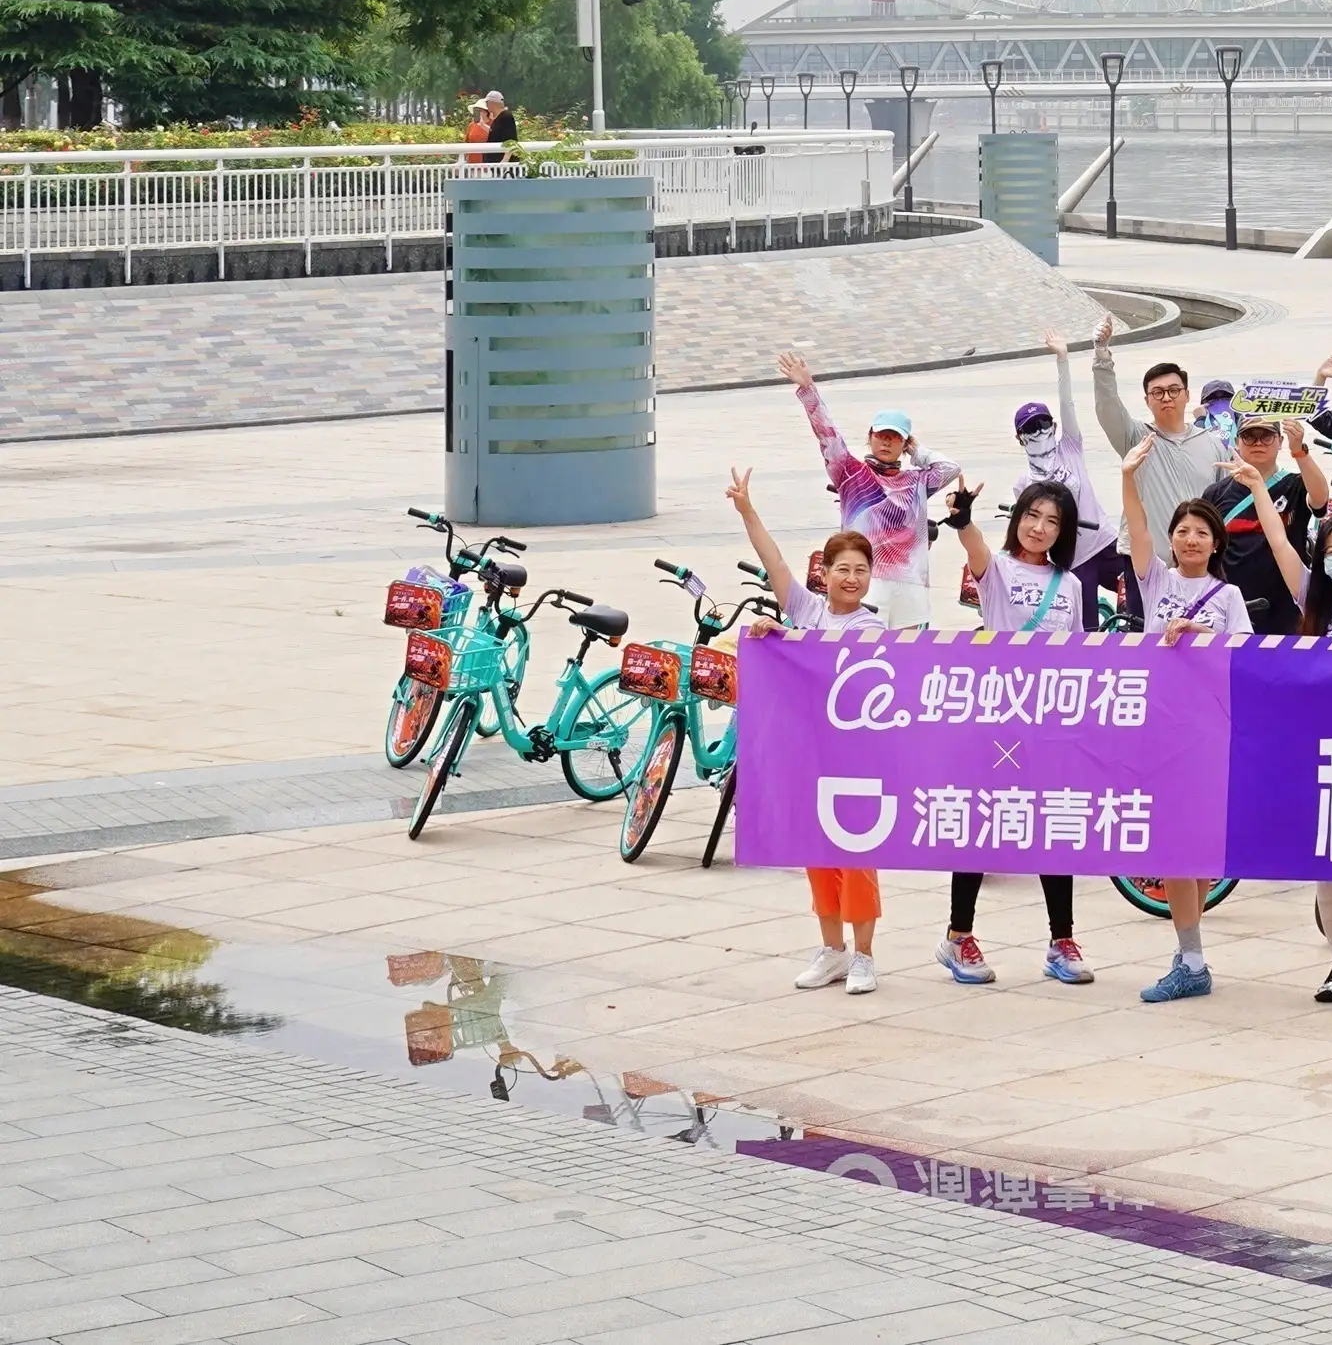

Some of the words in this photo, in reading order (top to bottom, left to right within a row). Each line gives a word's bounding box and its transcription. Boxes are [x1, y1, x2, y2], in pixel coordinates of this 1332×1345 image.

[1247, 387, 1326, 401] 科学减重一亿斤
[1255, 400, 1316, 414] 天津在行动
[918, 665, 1150, 727] 蚂蚁阿福
[912, 785, 1154, 853] 滴滴青桔
